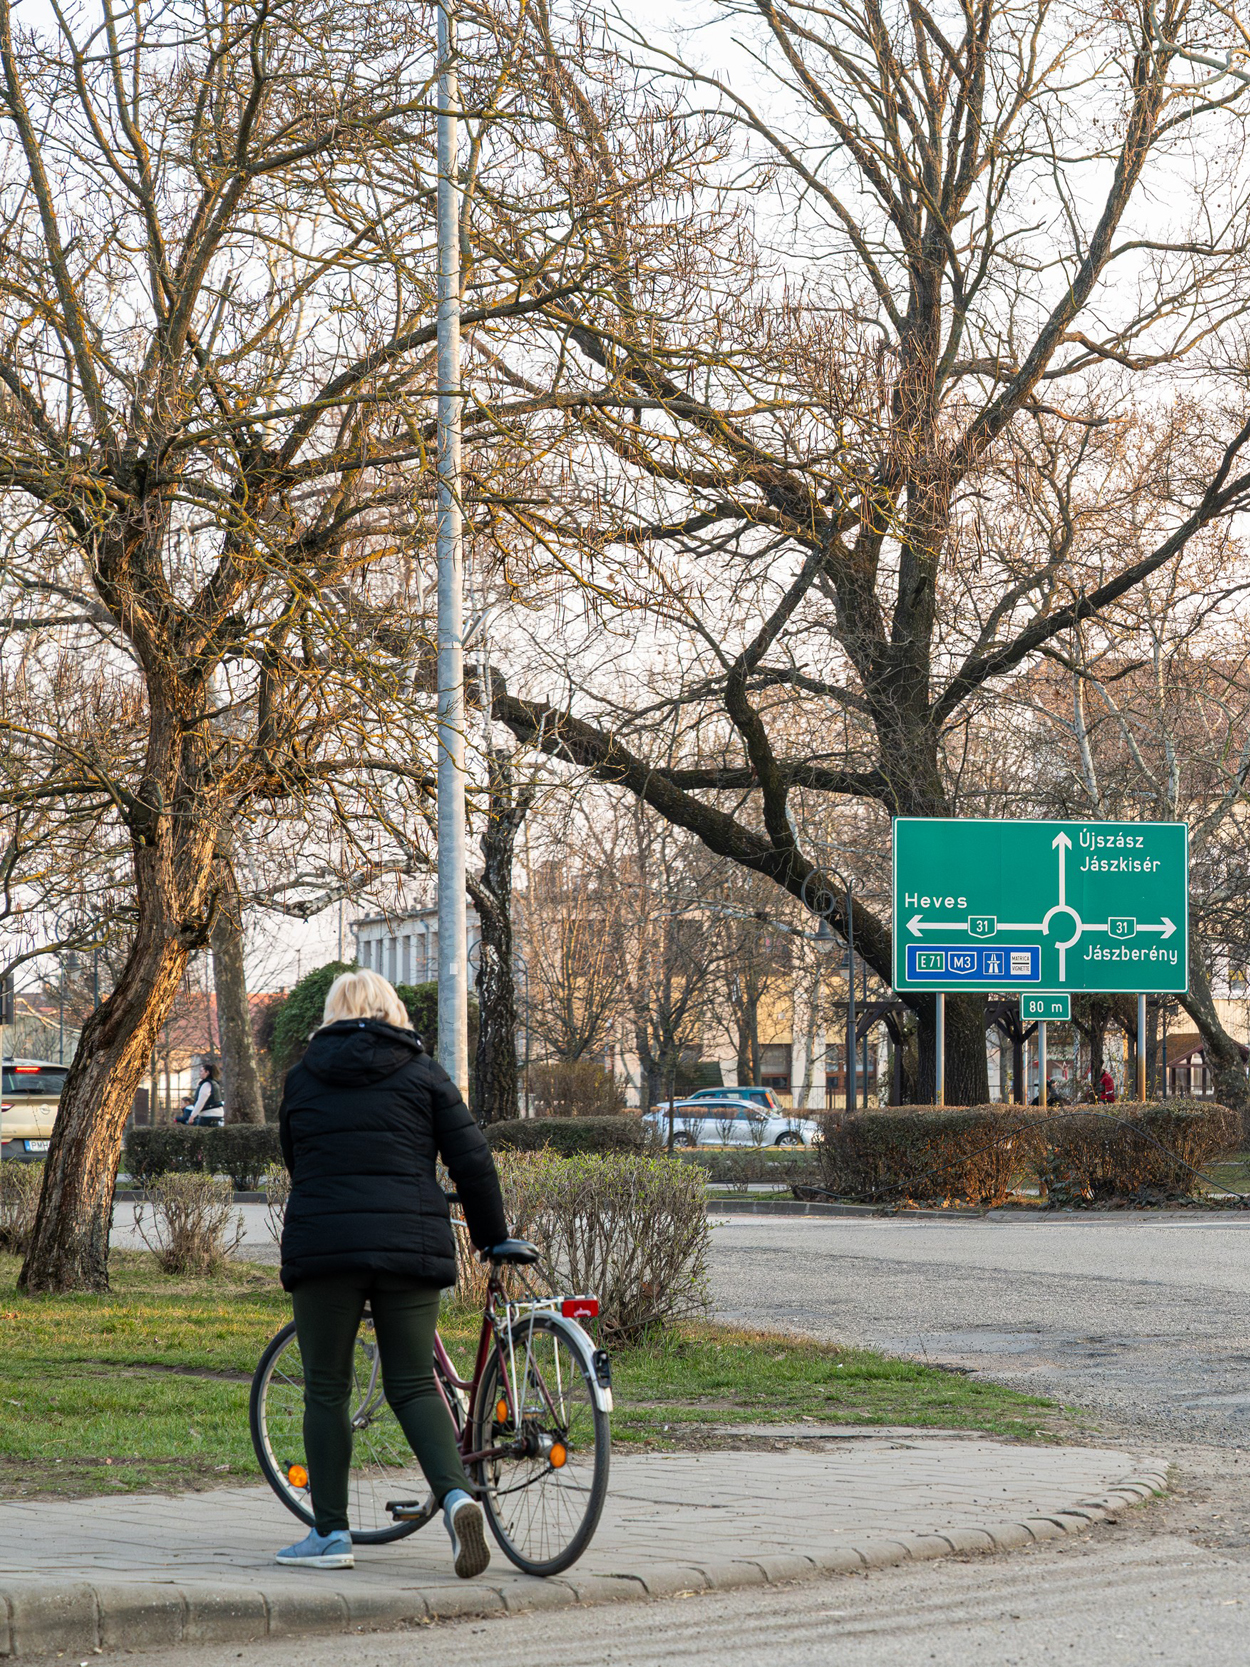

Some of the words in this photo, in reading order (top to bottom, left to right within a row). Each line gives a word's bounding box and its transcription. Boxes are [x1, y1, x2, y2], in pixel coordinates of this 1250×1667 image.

[1079, 828, 1144, 850] Újszász
[1080, 856, 1161, 872] Jászkisér
[905, 892, 968, 909] Heves
[976, 920, 988, 933] 31
[1116, 921, 1128, 934] 31
[1083, 945, 1178, 965] Jászberény
[953, 956, 971, 968] M3
[1029, 1001, 1044, 1013] 80
[1051, 1003, 1063, 1013] m
[31, 1141, 50, 1150] PMH
